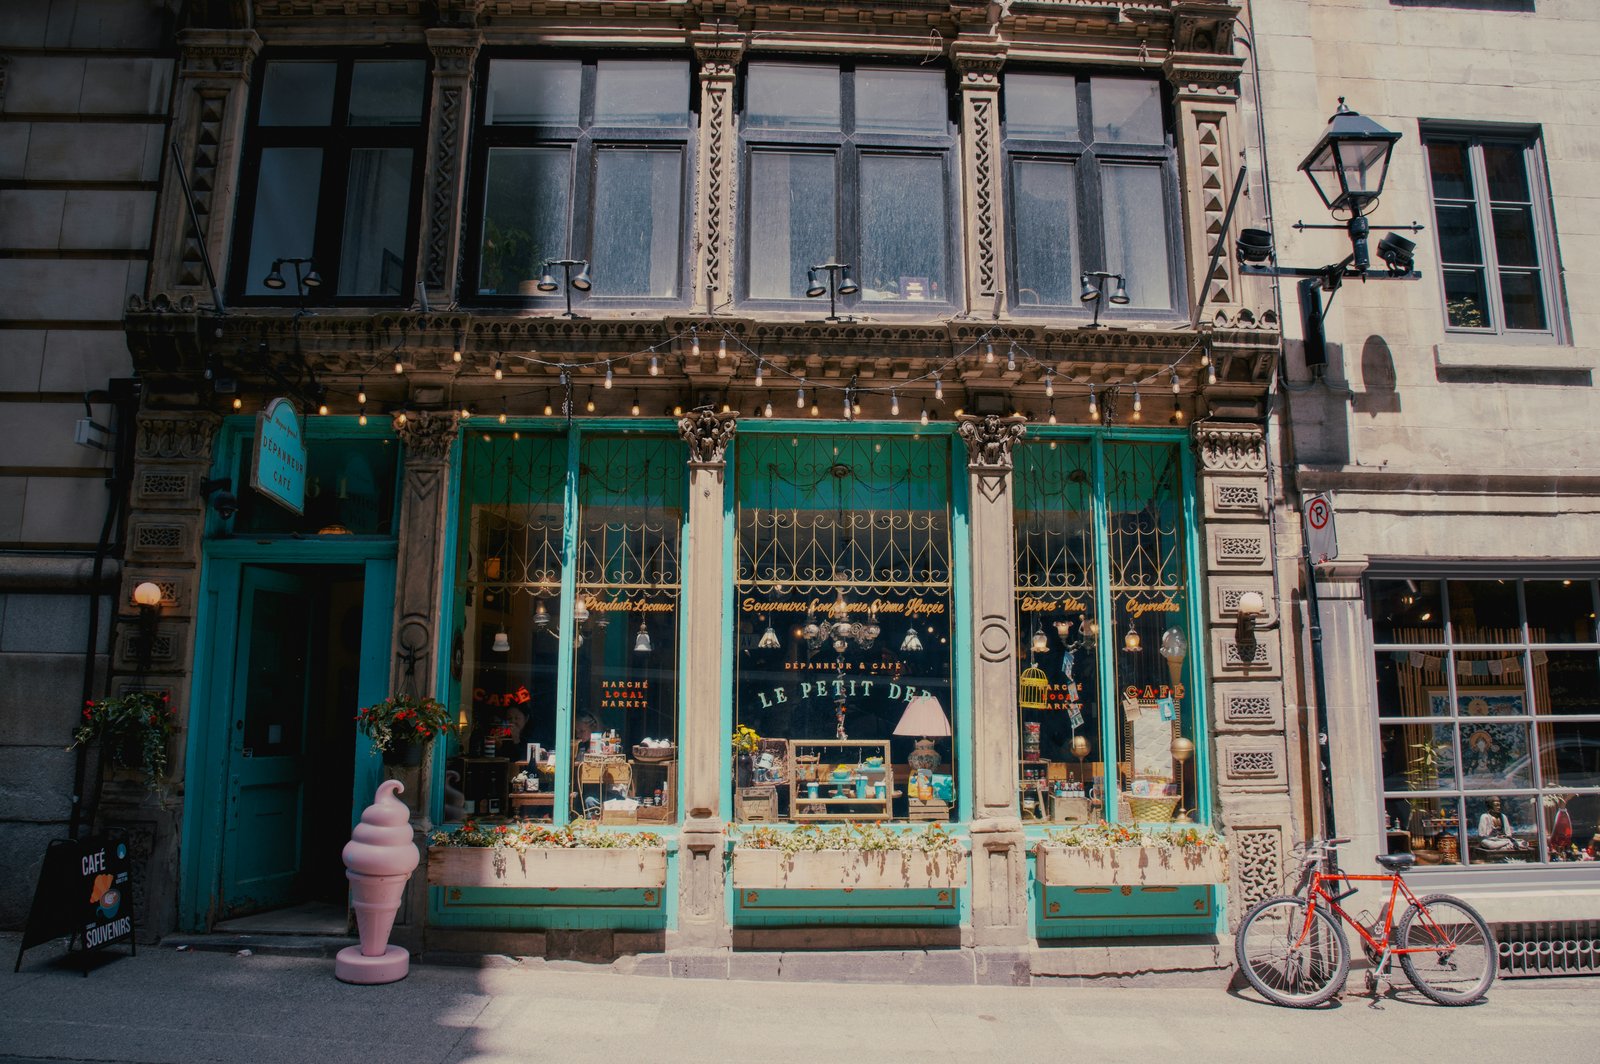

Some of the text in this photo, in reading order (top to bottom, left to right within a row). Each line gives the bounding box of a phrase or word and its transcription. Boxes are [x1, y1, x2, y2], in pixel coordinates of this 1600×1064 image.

[263, 435, 303, 473] DÉPANNEUR
[273, 471, 291, 491] CAFÉ
[1315, 506, 1323, 523] P
[585, 596, 675, 612] Produits Locaux
[742, 598, 806, 611] Souvenirs
[810, 598, 868, 619] Conferie
[905, 598, 944, 617] Glacée
[1063, 598, 1087, 611] Vin
[785, 661, 901, 670] DÉPANNEUR & CAFÉ
[602, 679, 648, 689] MARCHÉ
[1039, 682, 1083, 691] ARCÉ
[1125, 682, 1185, 699] CAFÉ
[473, 684, 531, 707] CAFÉ
[605, 691, 643, 699] LOCAL
[758, 687, 788, 709] LE
[801, 680, 873, 699] PETIT
[601, 700, 648, 708] MARKET
[81, 847, 106, 876] CAFÉ
[86, 916, 131, 949] SOUVENIRS
